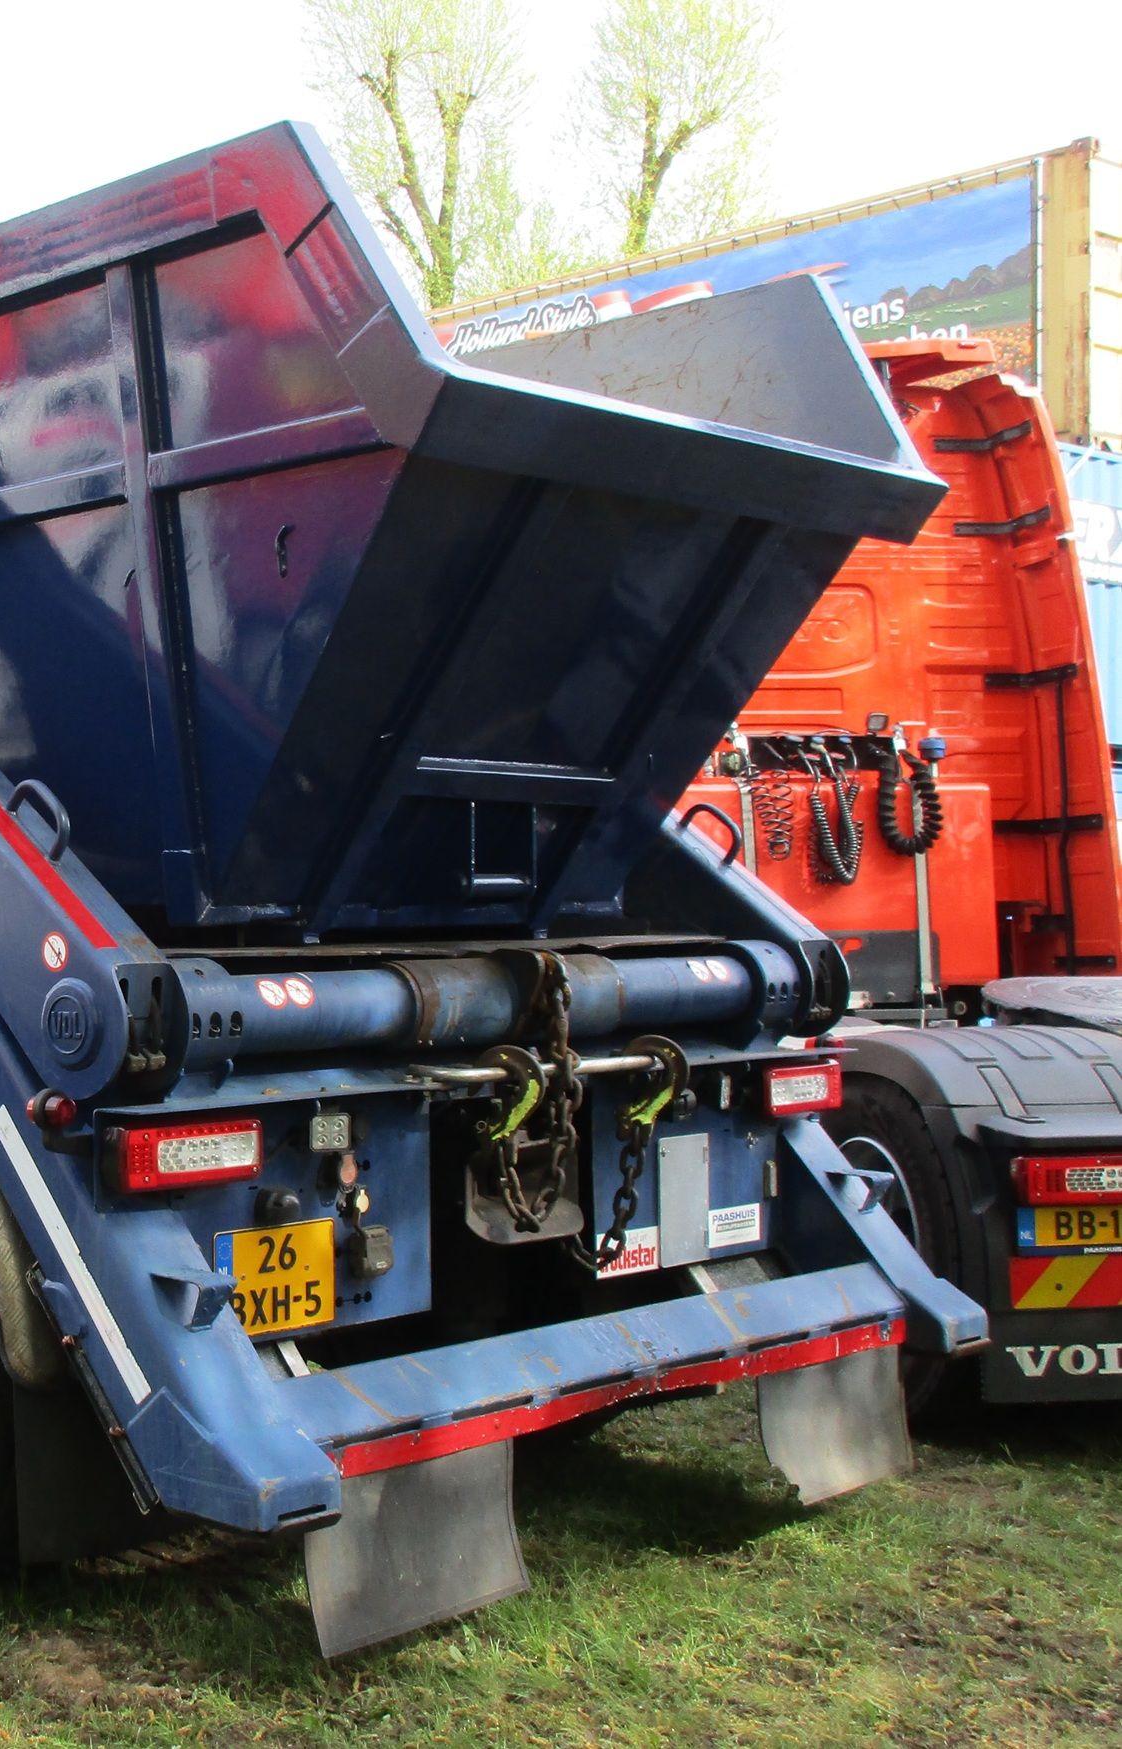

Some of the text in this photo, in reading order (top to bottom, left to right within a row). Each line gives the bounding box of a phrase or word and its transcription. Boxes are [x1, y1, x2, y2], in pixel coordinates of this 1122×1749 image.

[447, 296, 596, 356] Holland Style
[50, 1010, 83, 1040] VDL
[712, 1208, 756, 1225] PAASHUIS
[1055, 1209, 1120, 1241] BB-1
[258, 1233, 298, 1275] 26
[228, 1280, 323, 1328] BXH-5
